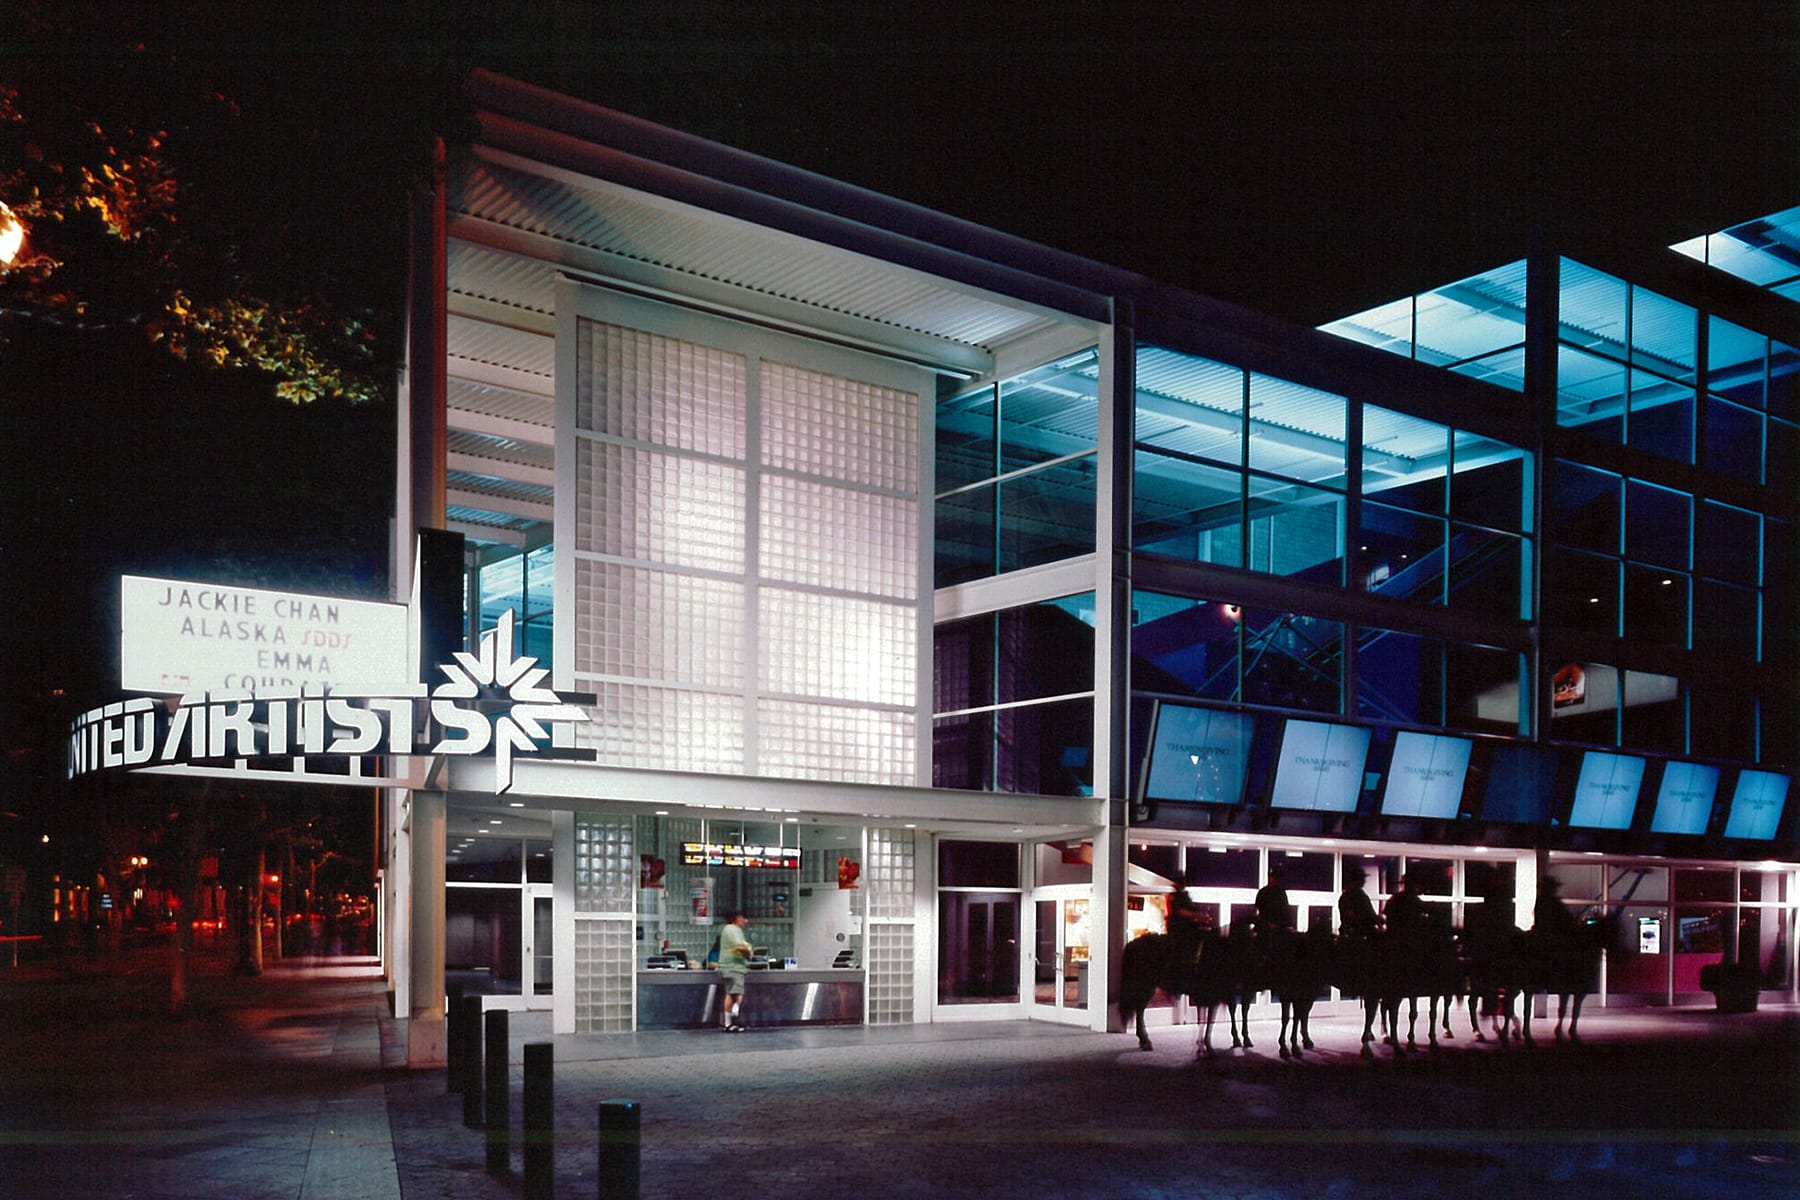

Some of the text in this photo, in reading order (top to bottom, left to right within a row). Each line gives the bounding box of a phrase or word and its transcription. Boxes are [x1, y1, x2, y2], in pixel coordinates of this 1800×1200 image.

[158, 587, 340, 624] JACKIE CHAN
[180, 617, 286, 644] ALASKA
[257, 650, 331, 673] EMMA
[67, 683, 492, 779] UNITED ARTISTS
